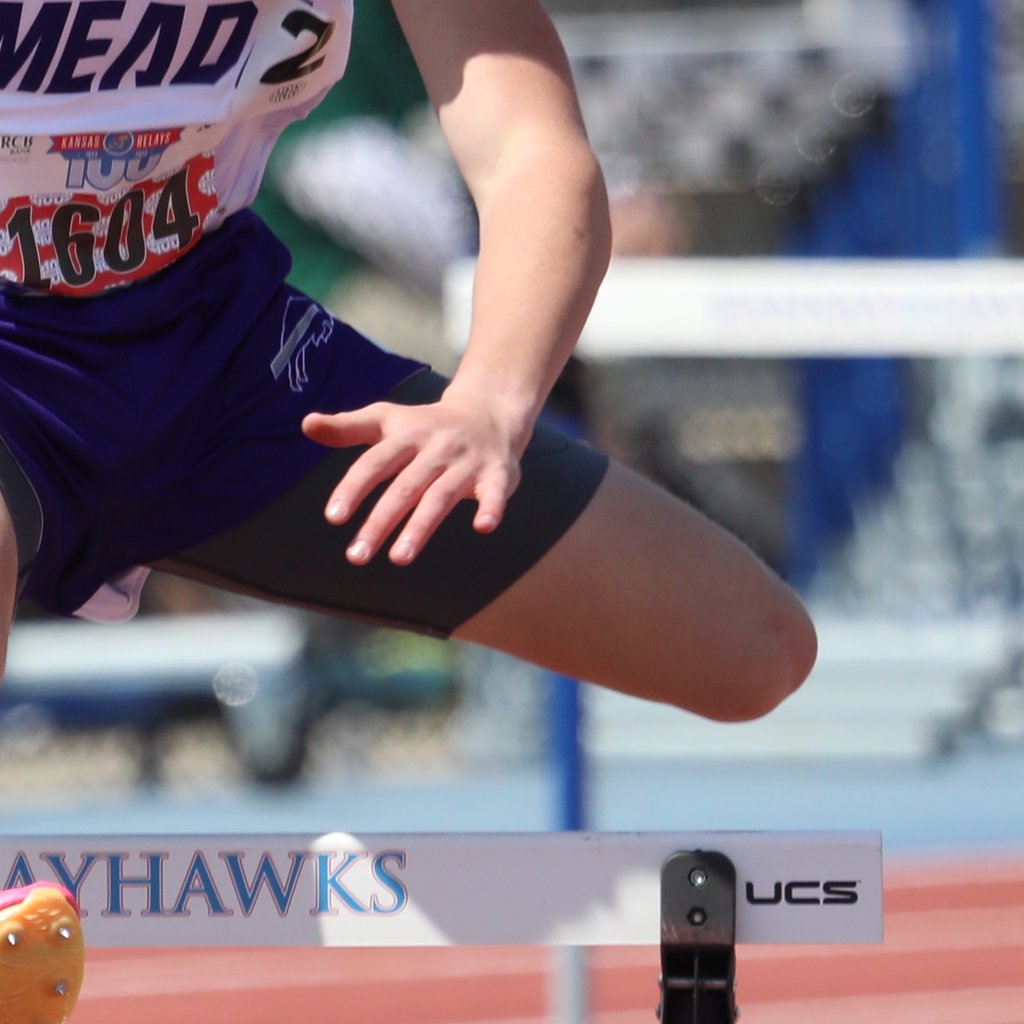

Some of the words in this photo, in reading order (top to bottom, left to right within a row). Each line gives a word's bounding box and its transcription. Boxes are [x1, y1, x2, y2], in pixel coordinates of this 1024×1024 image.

[259, 9, 335, 85] 2
[0, 135, 33, 149] RCB
[61, 134, 101, 150] KANSAS
[136, 130, 172, 148] RELAYS
[5, 165, 201, 290] 1604
[745, 880, 859, 905] UCS
